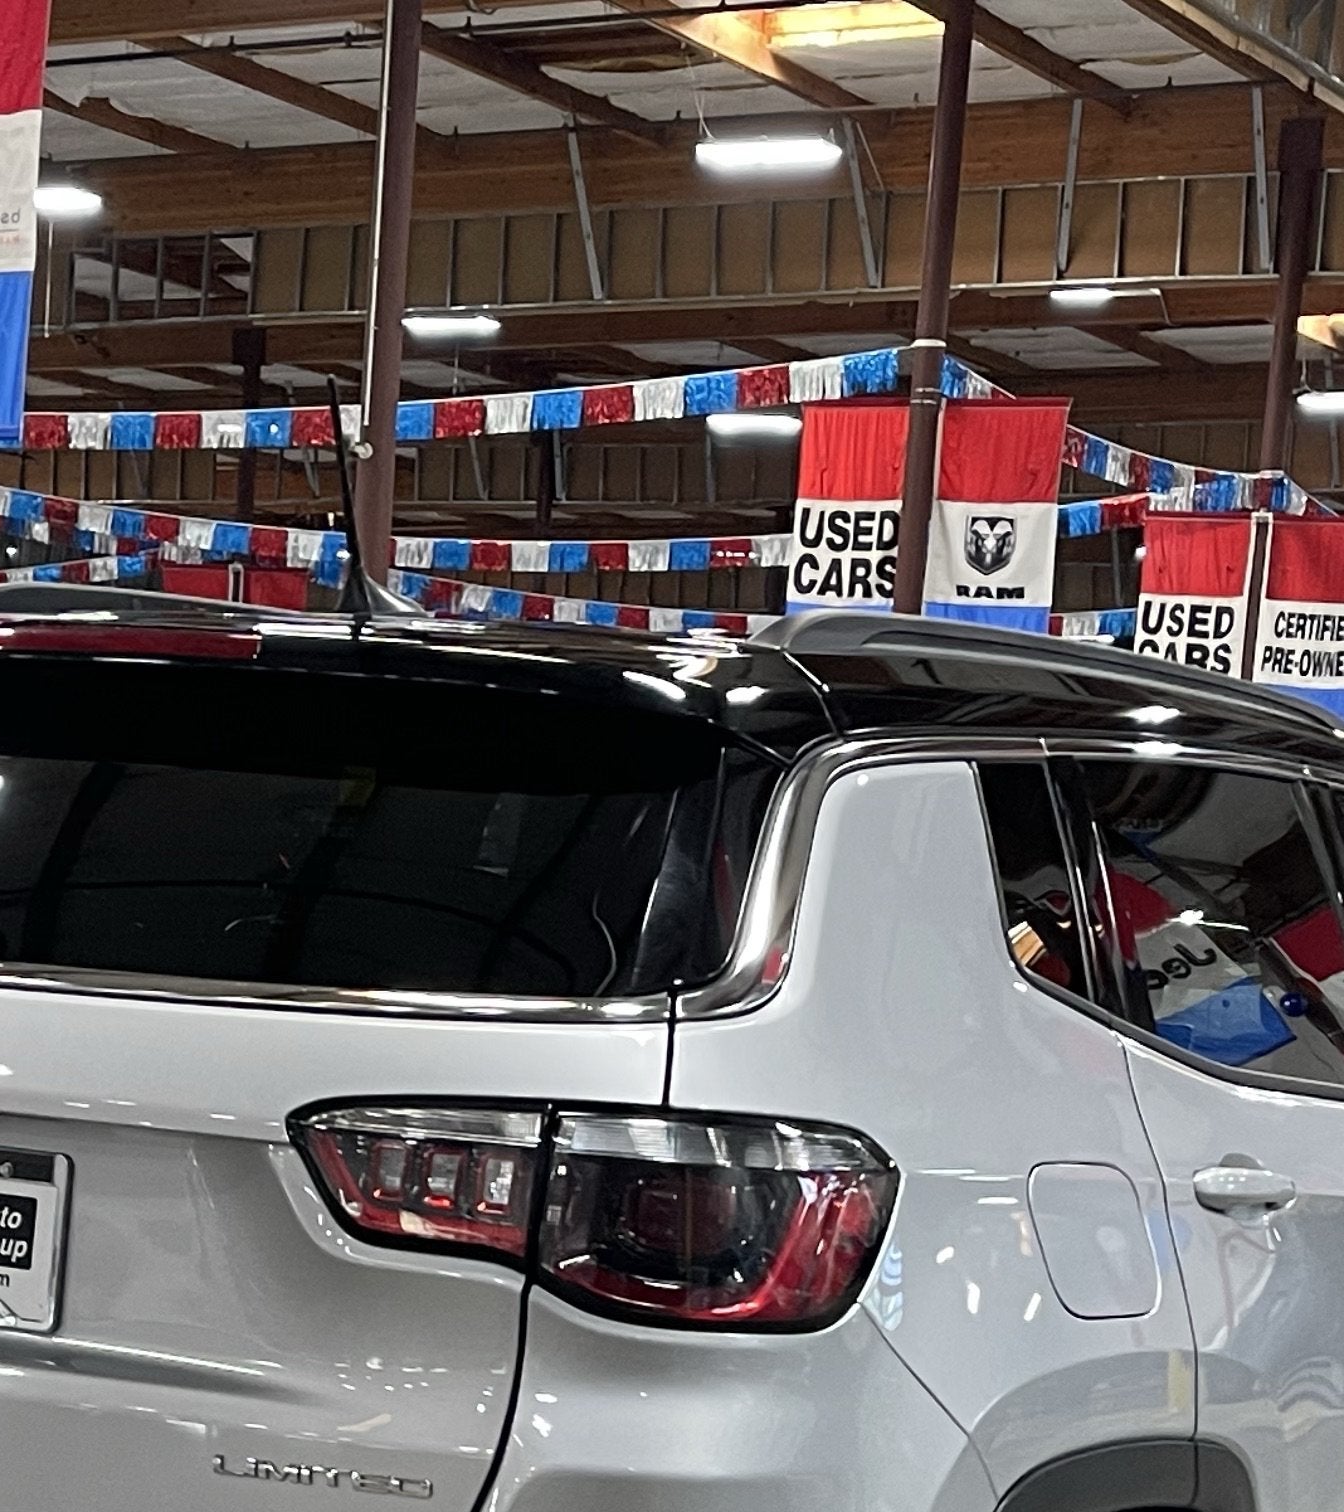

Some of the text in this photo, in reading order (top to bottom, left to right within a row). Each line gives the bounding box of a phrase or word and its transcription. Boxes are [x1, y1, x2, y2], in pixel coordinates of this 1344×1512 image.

[799, 507, 900, 552] USED
[793, 553, 897, 599] CARS
[956, 585, 1025, 600] RAM
[1140, 600, 1235, 639] USED
[212, 1453, 434, 1500] LIMITED
